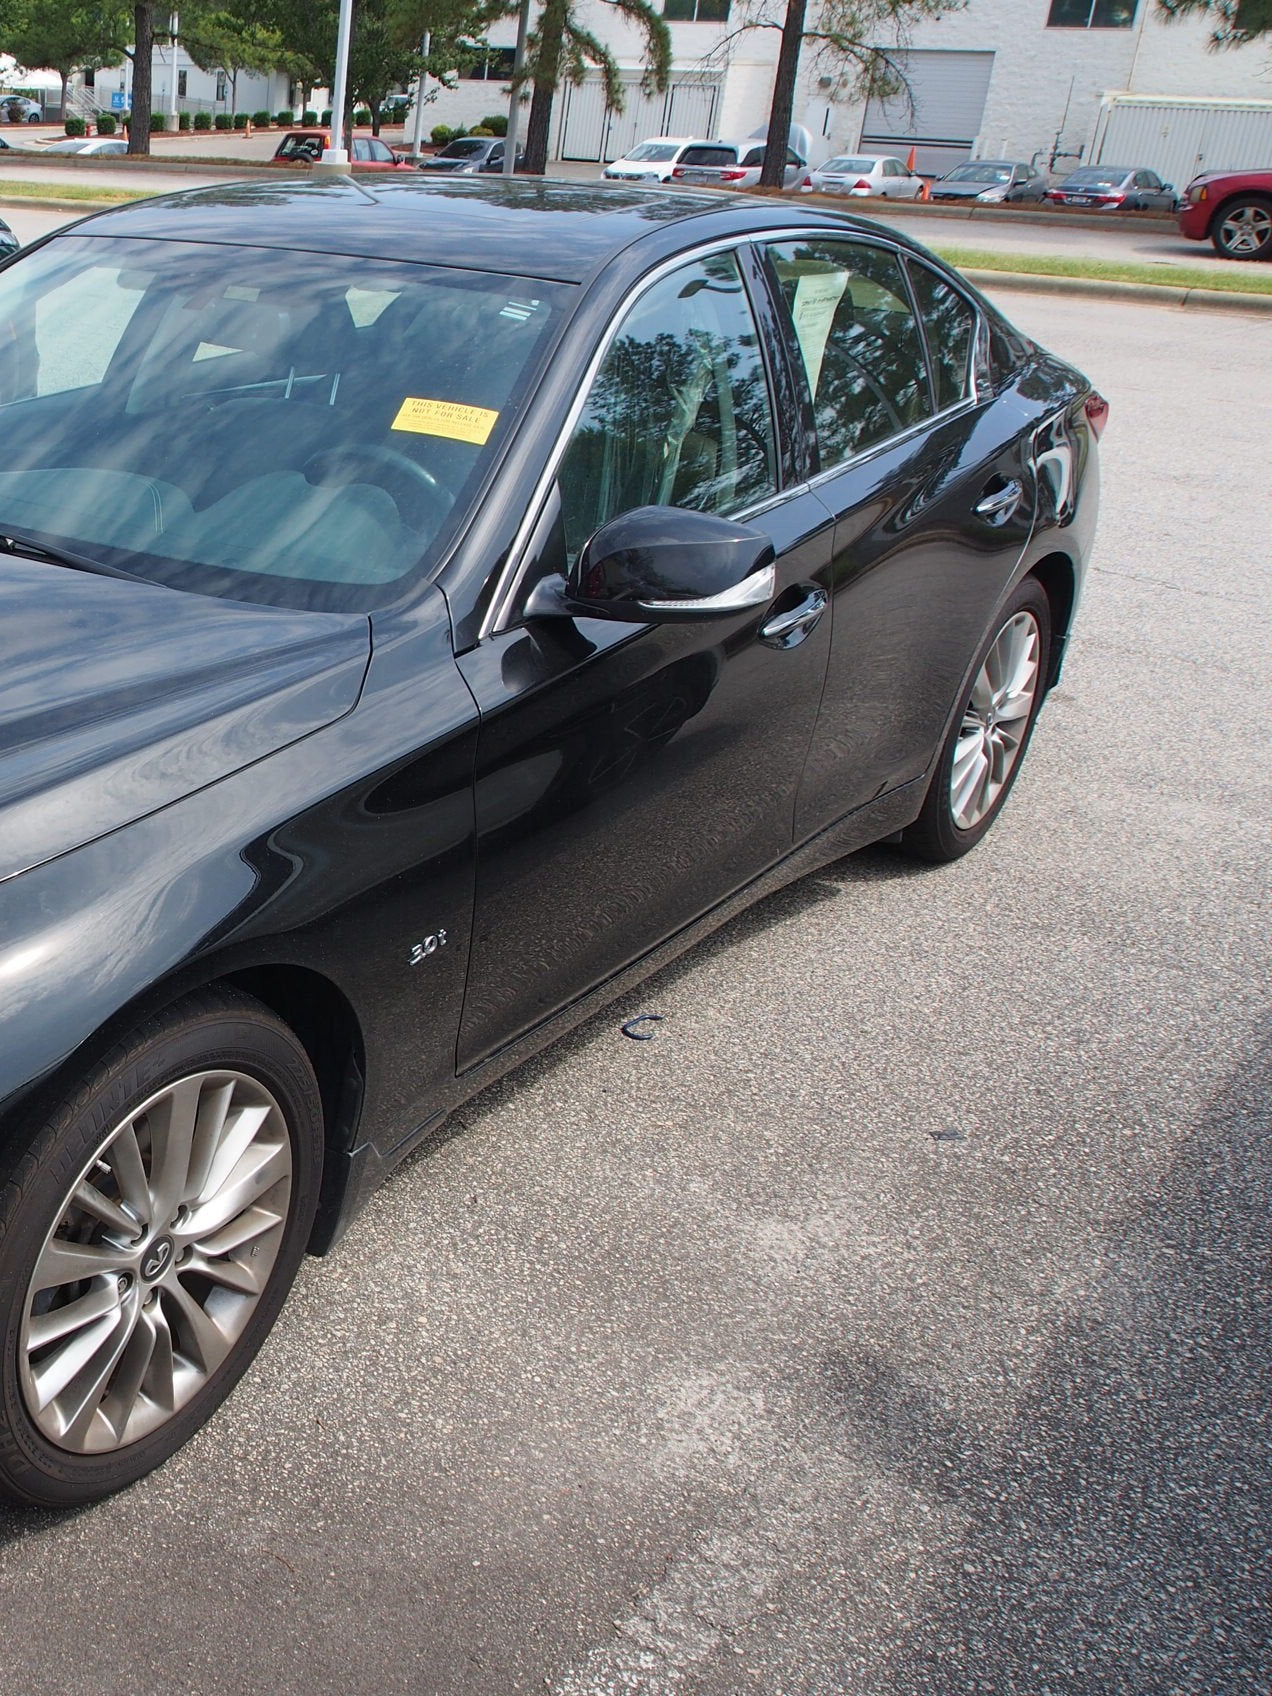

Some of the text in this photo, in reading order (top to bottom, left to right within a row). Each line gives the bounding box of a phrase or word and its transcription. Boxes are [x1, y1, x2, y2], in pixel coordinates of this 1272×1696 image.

[411, 400, 432, 408] THIS
[436, 404, 474, 415] VEHICLE
[411, 407, 432, 415] NOT
[456, 414, 481, 424] SALE
